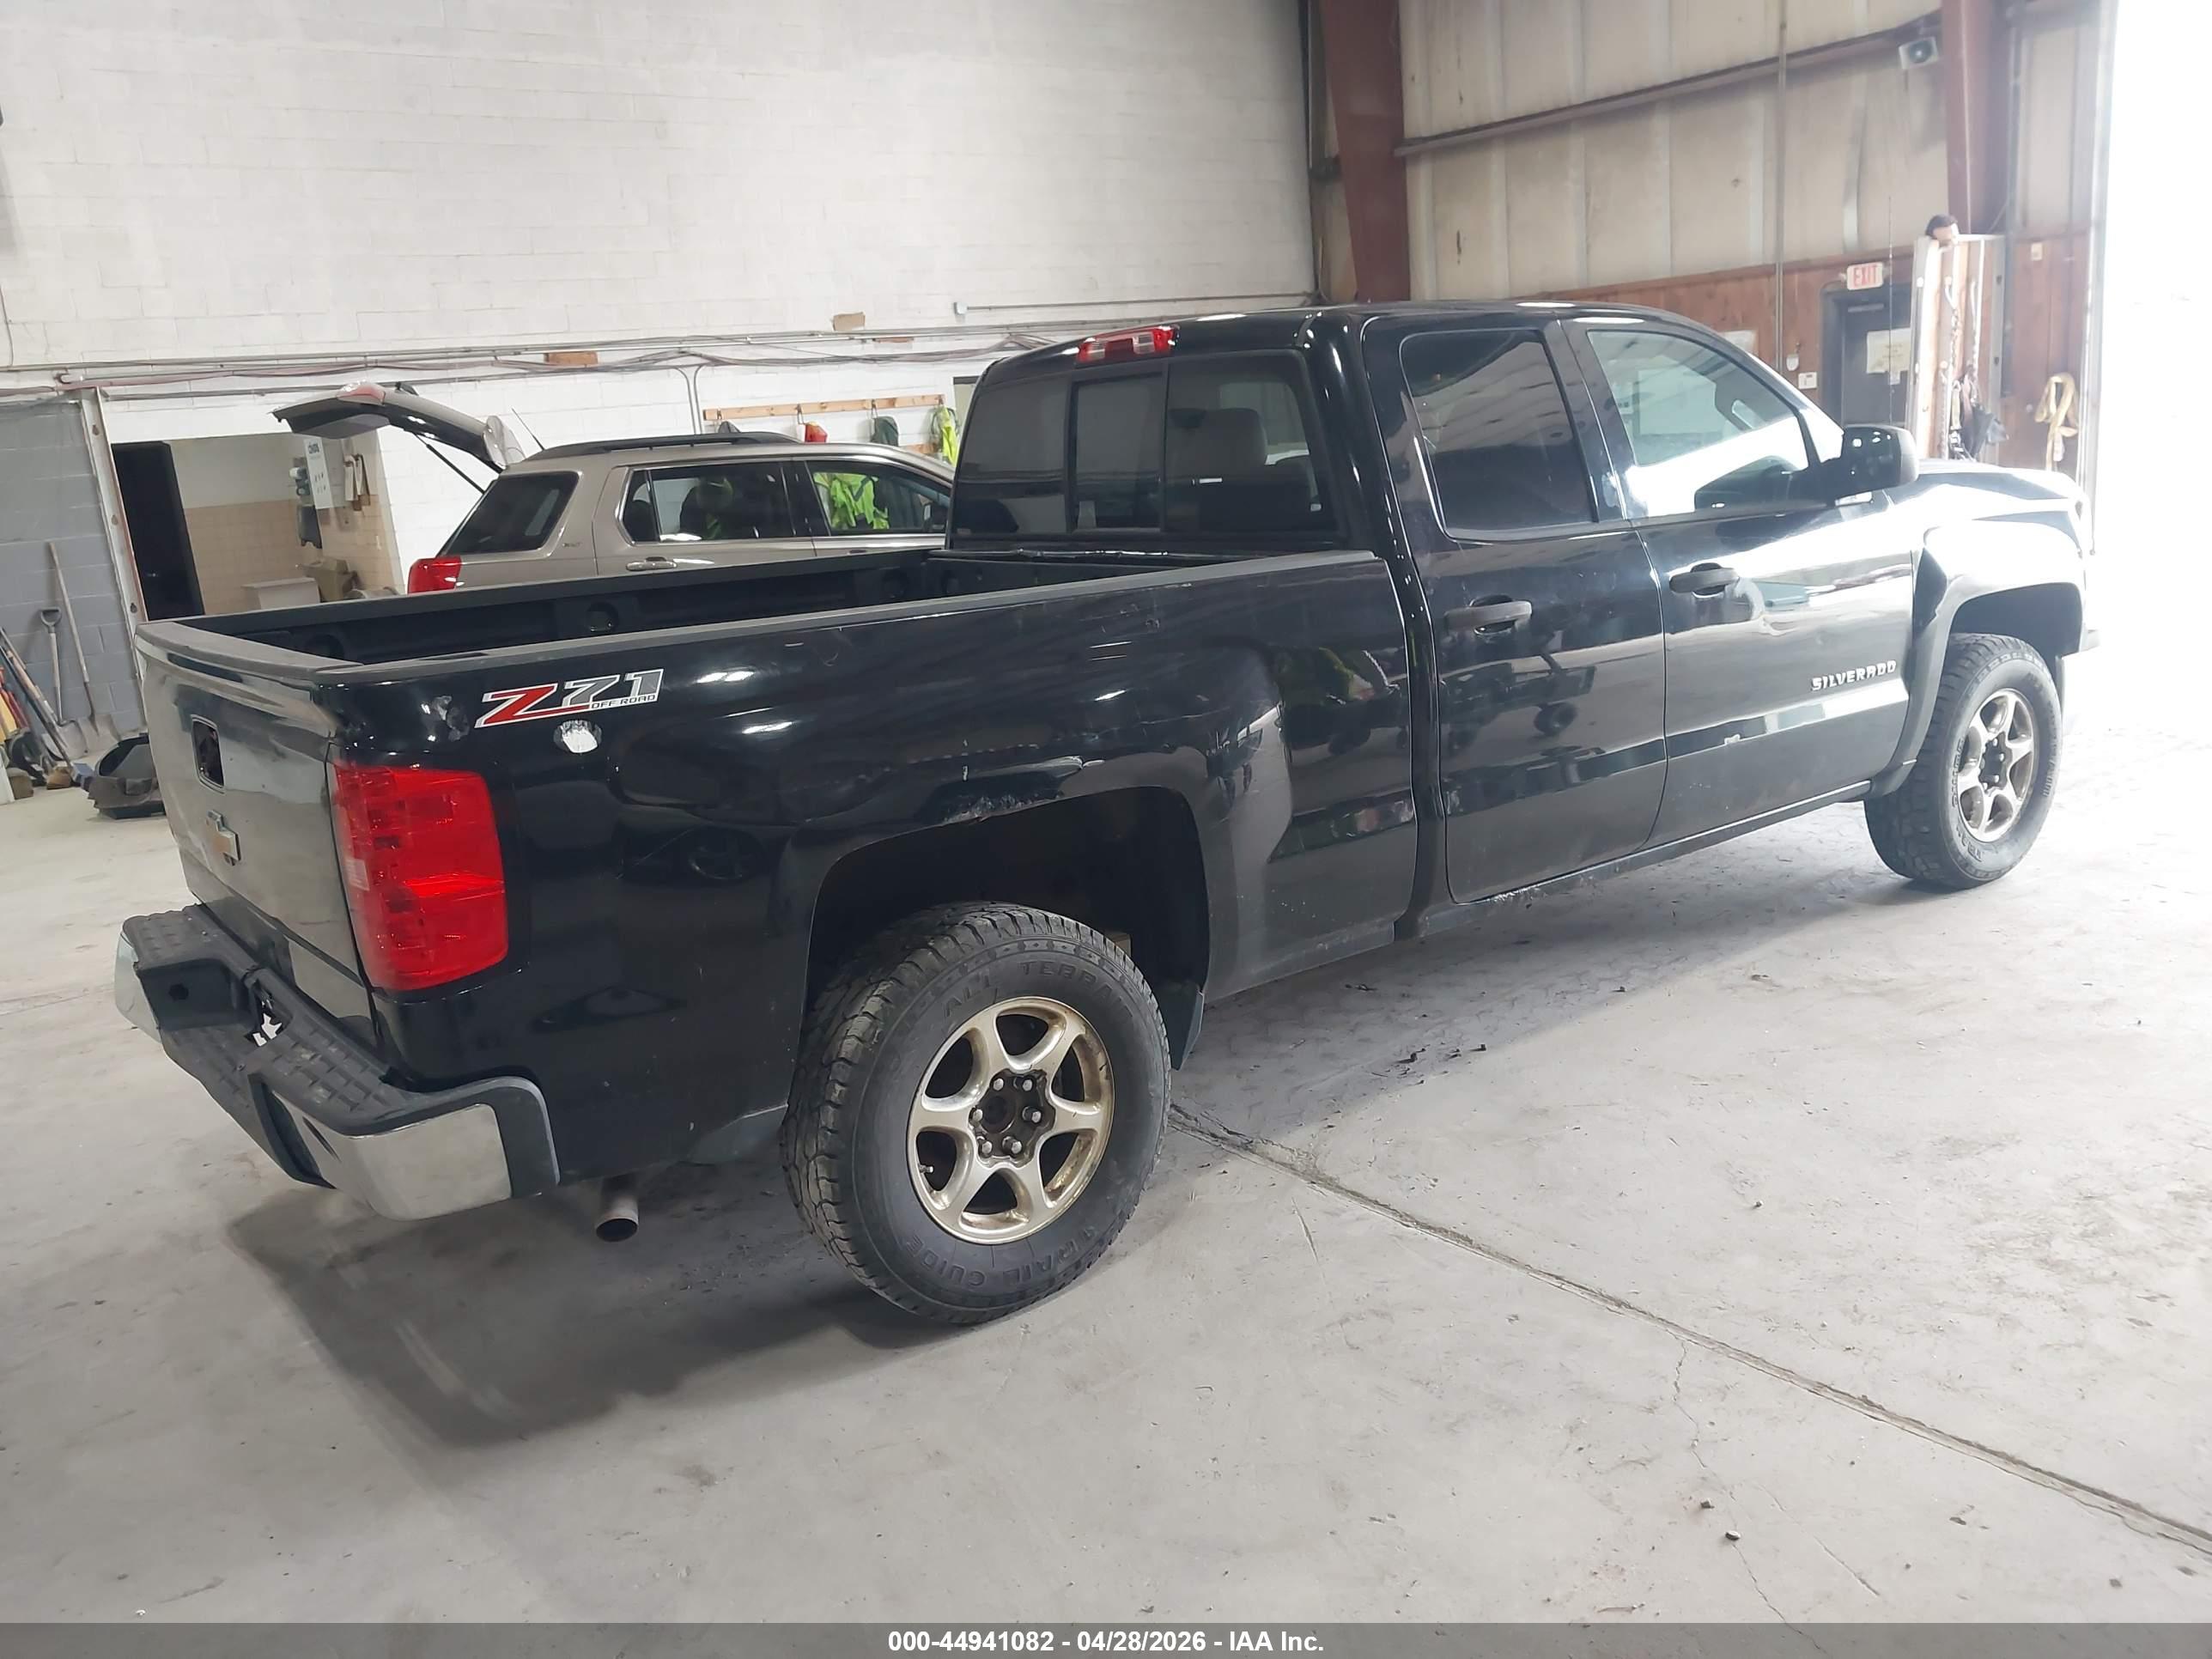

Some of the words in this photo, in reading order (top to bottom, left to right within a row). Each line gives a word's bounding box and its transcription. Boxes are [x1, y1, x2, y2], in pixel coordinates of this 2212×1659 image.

[1852, 264, 1878, 288] EXIT
[1811, 659, 1897, 691] SILVERADO
[474, 669, 665, 729] Z71
[591, 699, 617, 709] OFF
[620, 694, 656, 705] ROAD
